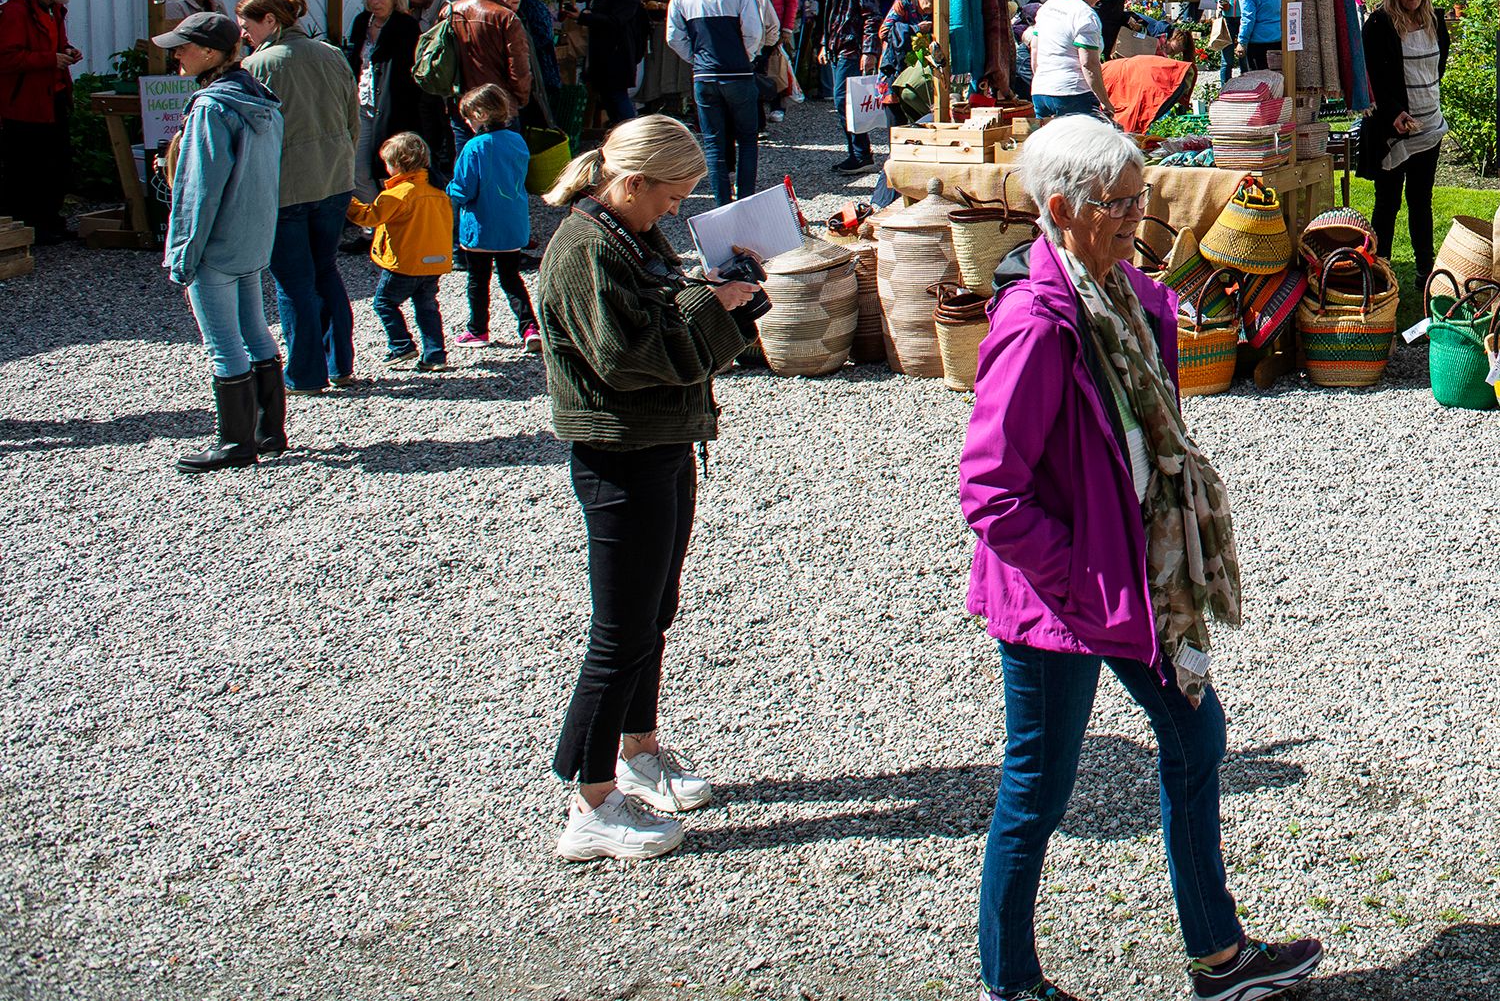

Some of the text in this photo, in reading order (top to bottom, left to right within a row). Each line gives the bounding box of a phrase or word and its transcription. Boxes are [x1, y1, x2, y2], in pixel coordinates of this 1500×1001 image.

[145, 79, 196, 97] KONNER
[147, 96, 190, 112] HAGELA
[599, 211, 644, 259] EOS DIGITAL
